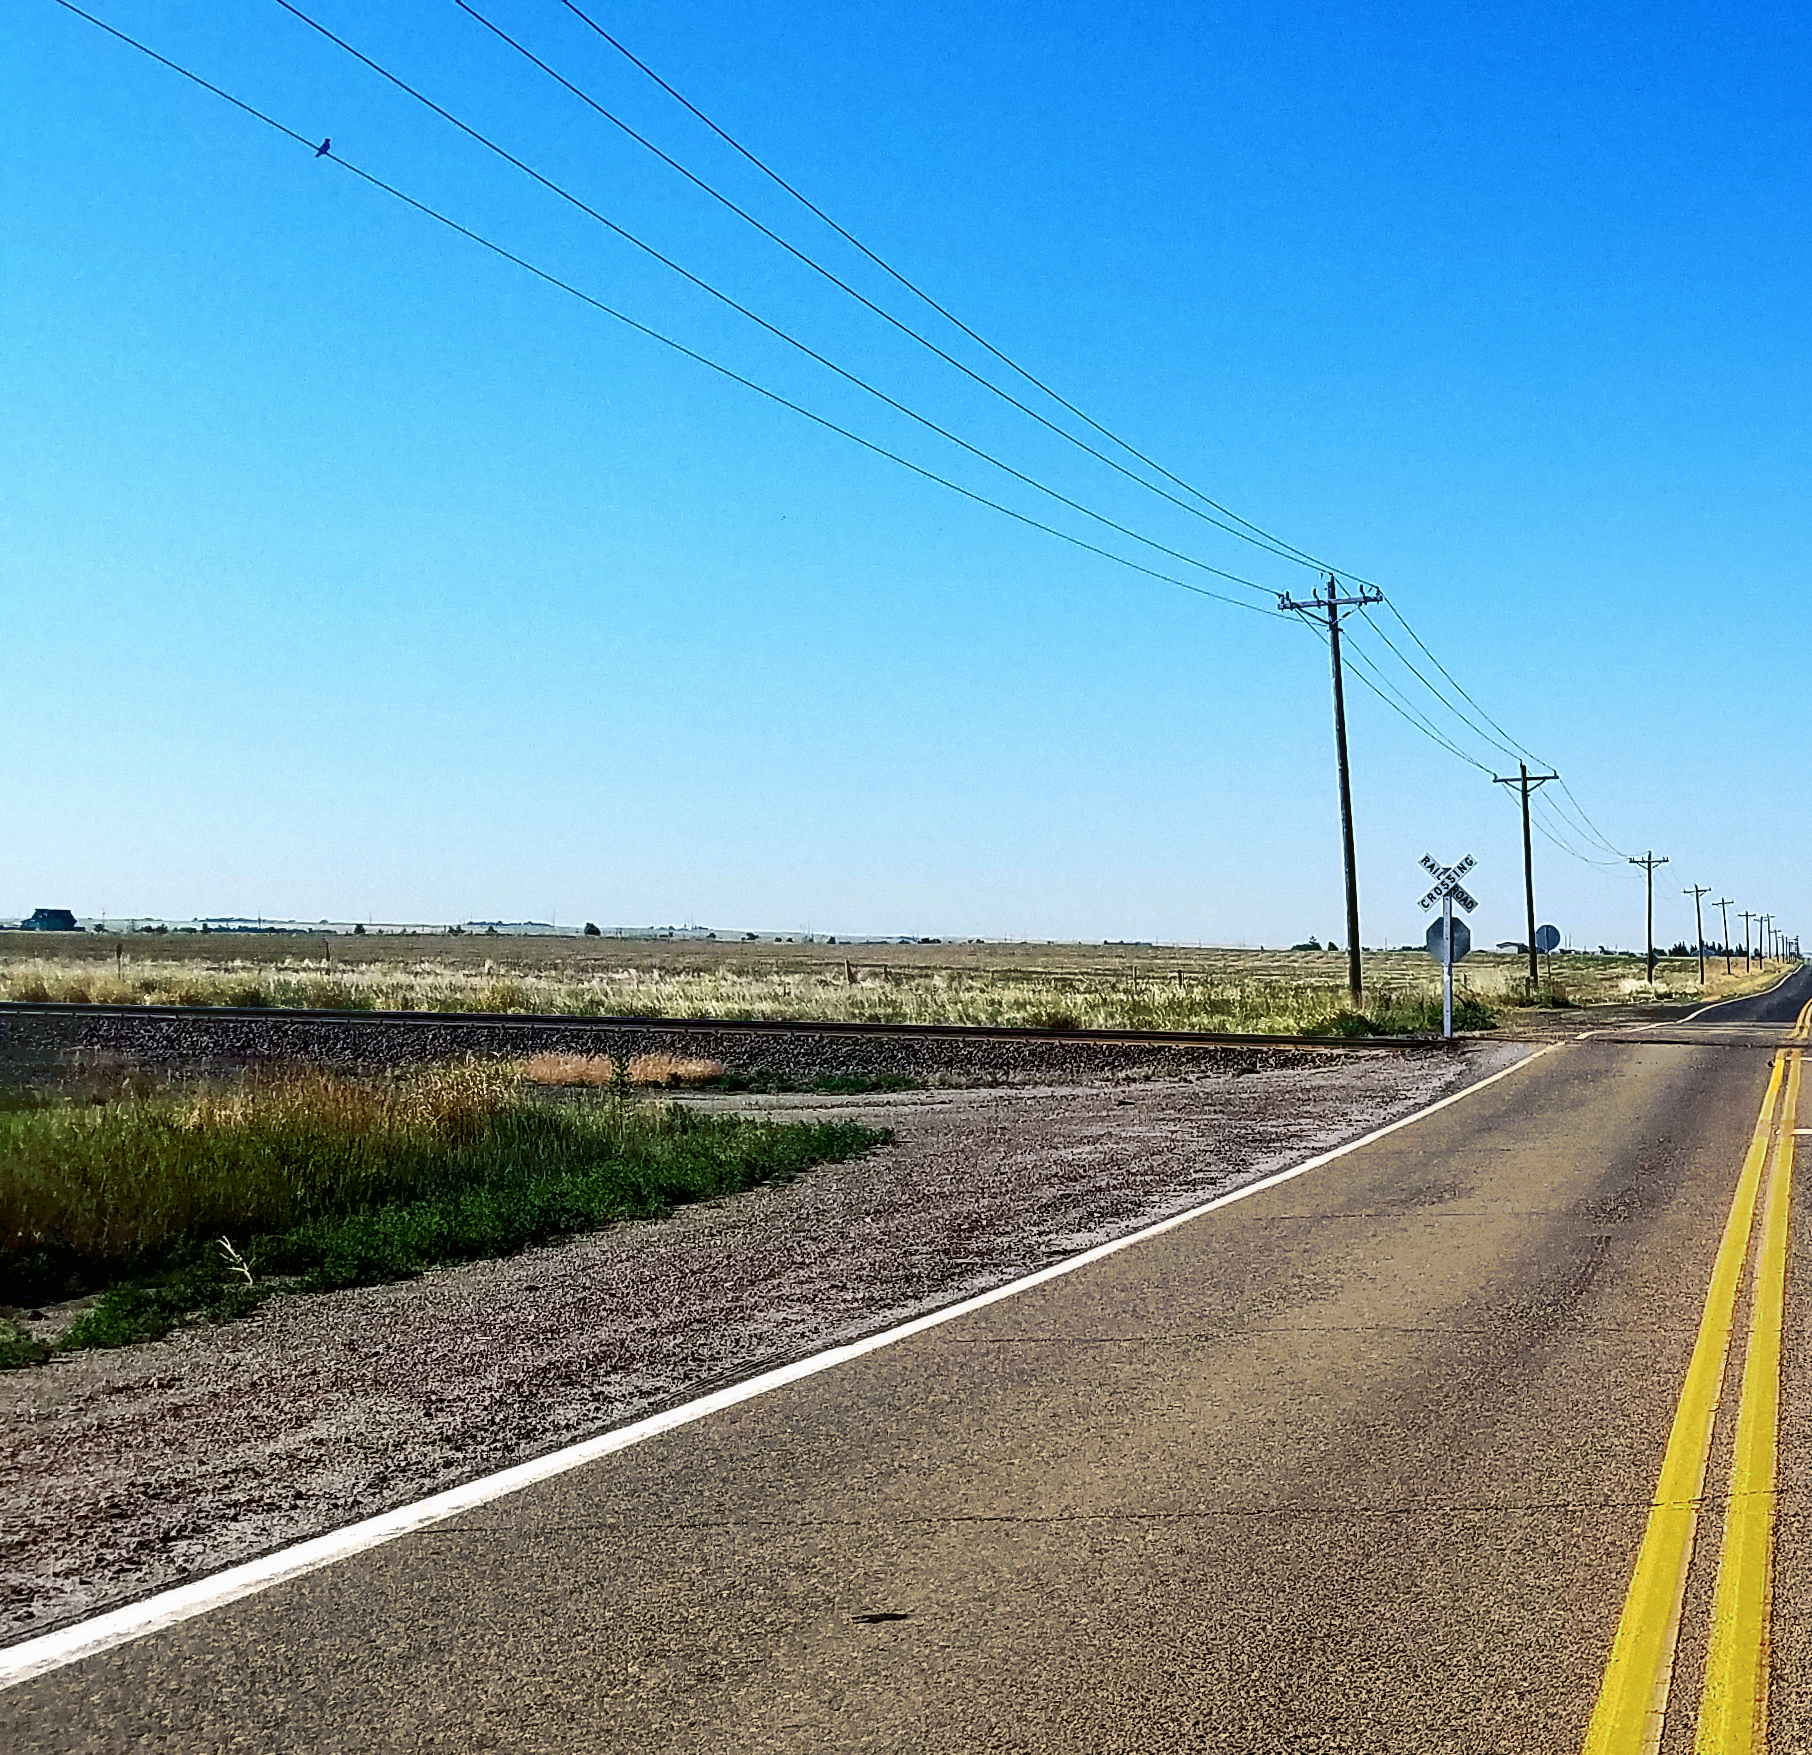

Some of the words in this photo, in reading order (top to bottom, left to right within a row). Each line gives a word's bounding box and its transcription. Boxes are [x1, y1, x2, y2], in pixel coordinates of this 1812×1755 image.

[1420, 855, 1444, 881] RAIL
[1451, 884, 1475, 910] ROAD
[1420, 856, 1474, 909] CROSSING
